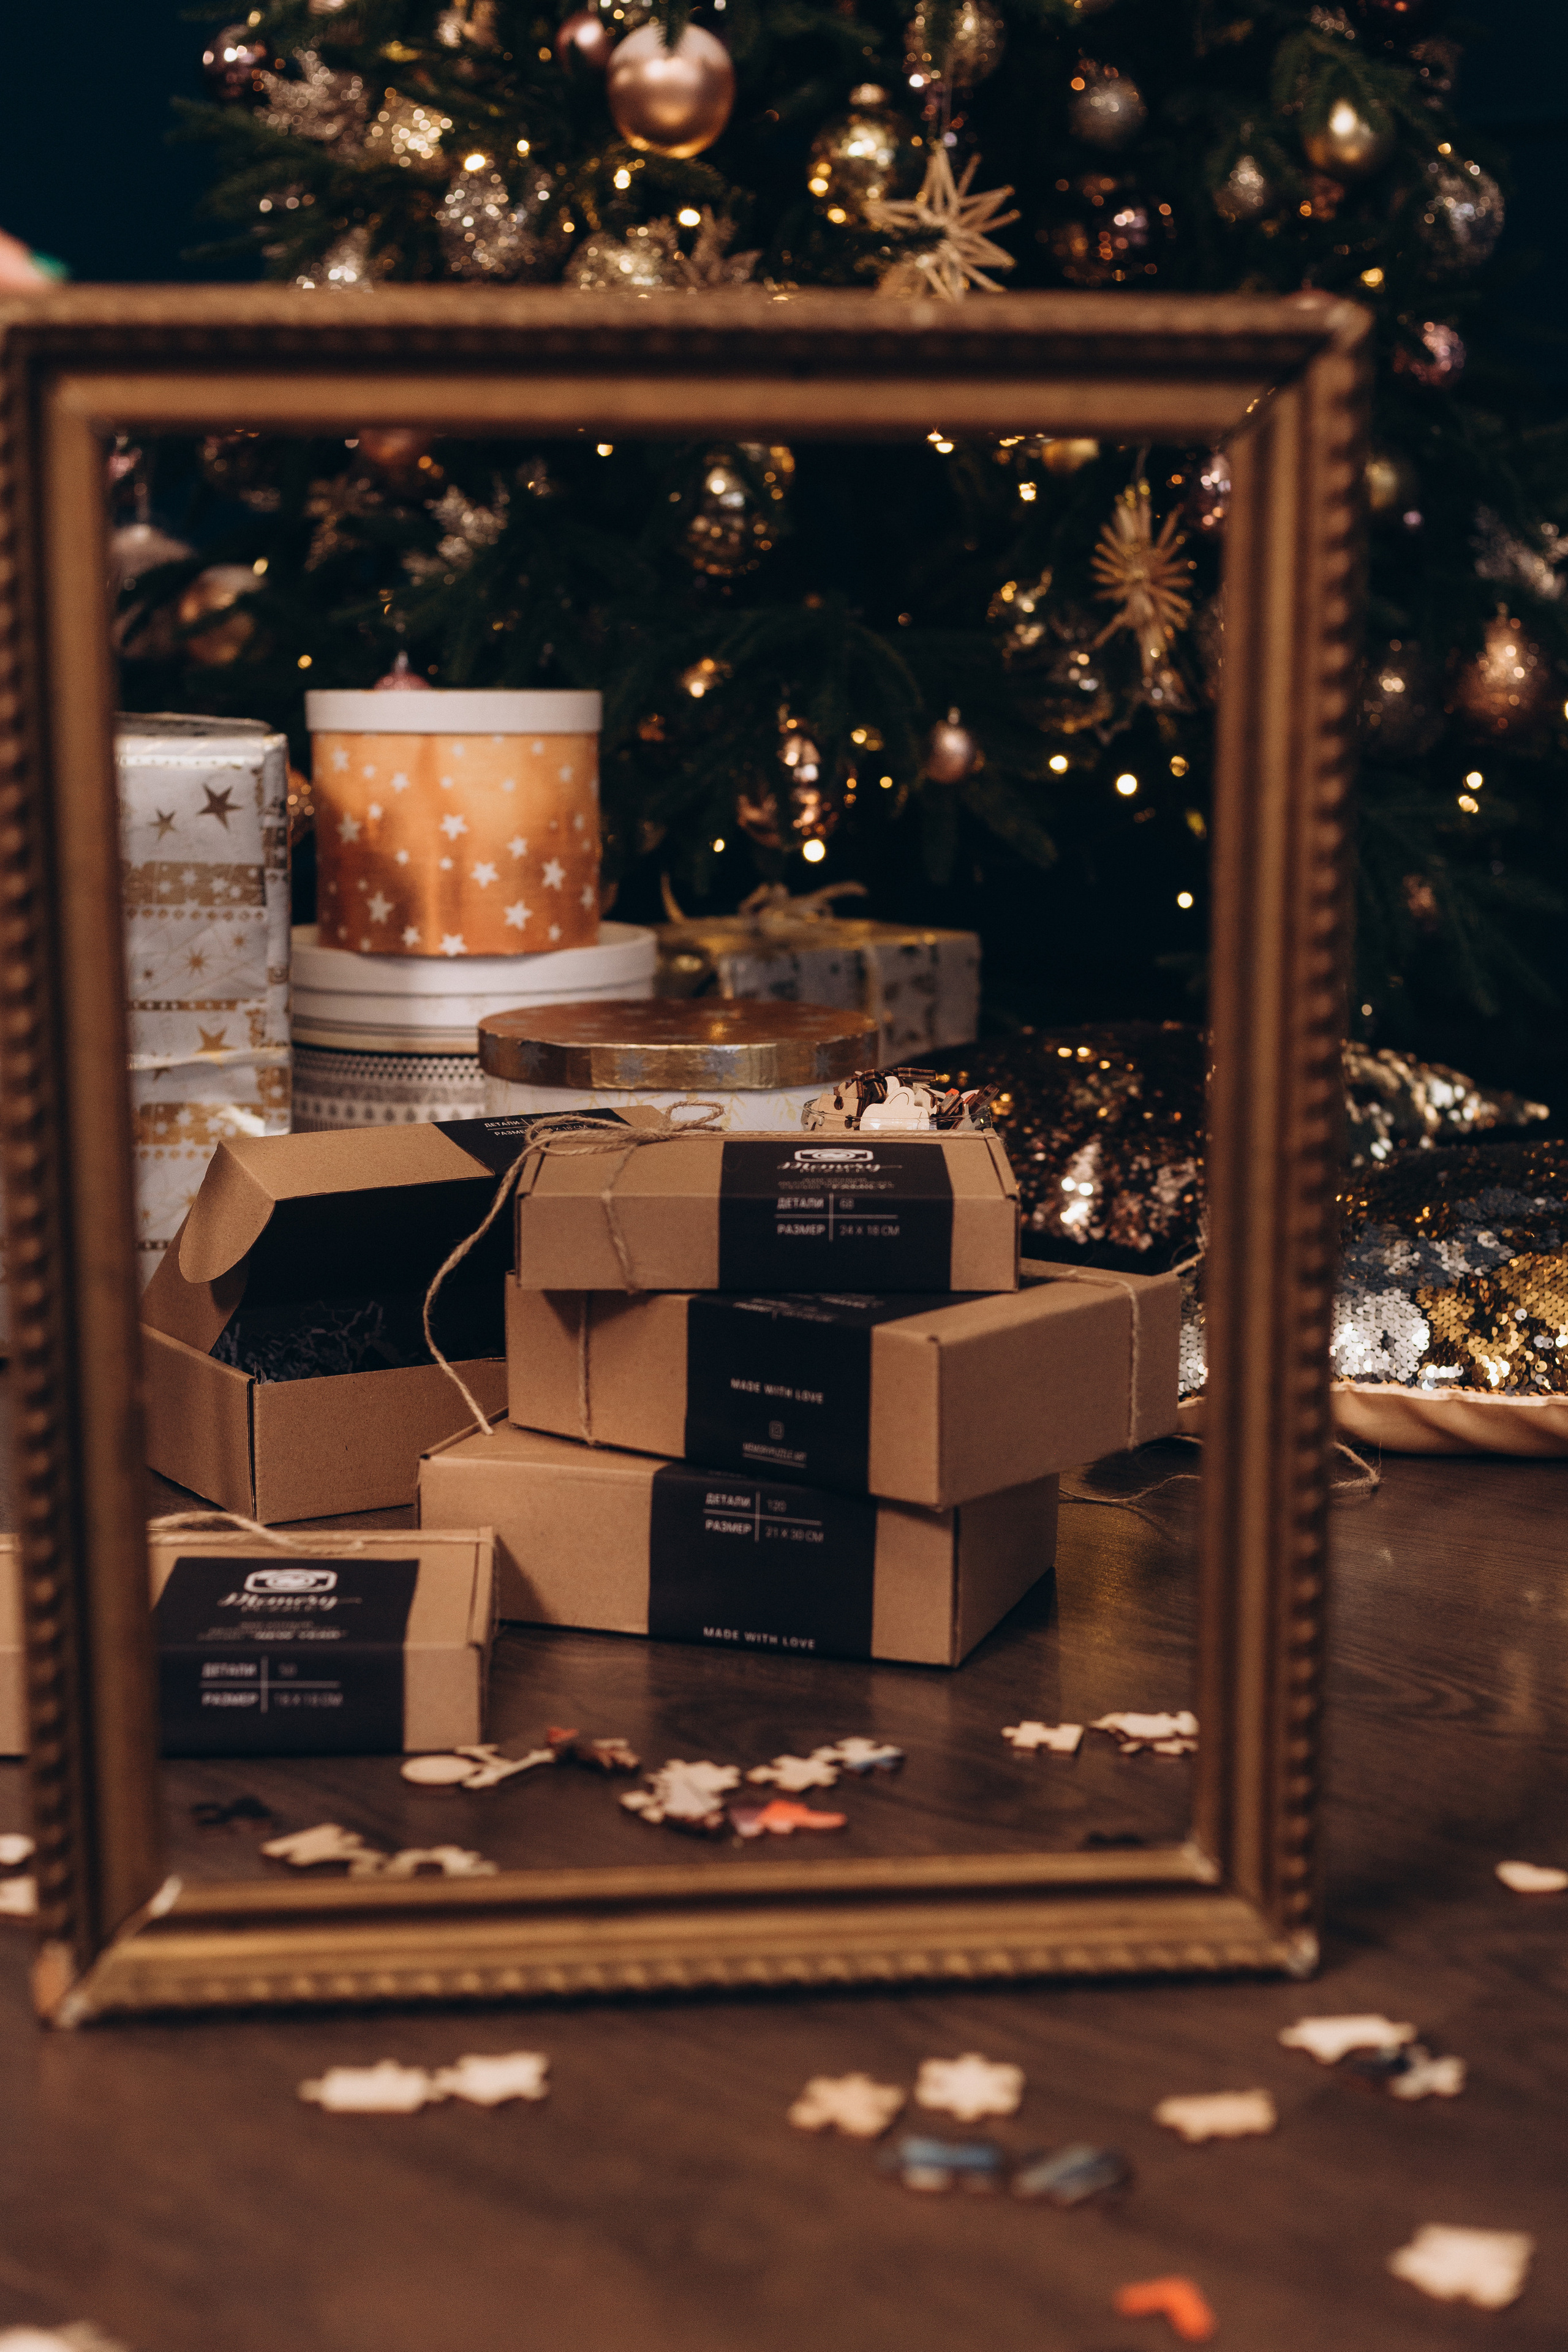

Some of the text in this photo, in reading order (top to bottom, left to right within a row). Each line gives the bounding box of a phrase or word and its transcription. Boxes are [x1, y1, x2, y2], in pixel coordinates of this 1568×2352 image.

[777, 1197, 824, 1210] ДЕТАЛИ
[777, 1224, 826, 1236] РАЗМЕР
[730, 1378, 824, 1405] MADE WITH LOVE
[706, 1493, 751, 1508] ДЕТАЛИ
[705, 1519, 752, 1535] РАЗМЕР
[216, 1592, 363, 1611] Memory
[703, 1626, 815, 1649] MADE WITH LOVE
[201, 1662, 257, 1678] ДЕТАЛИ
[201, 1692, 259, 1707] РАЗМЕР
